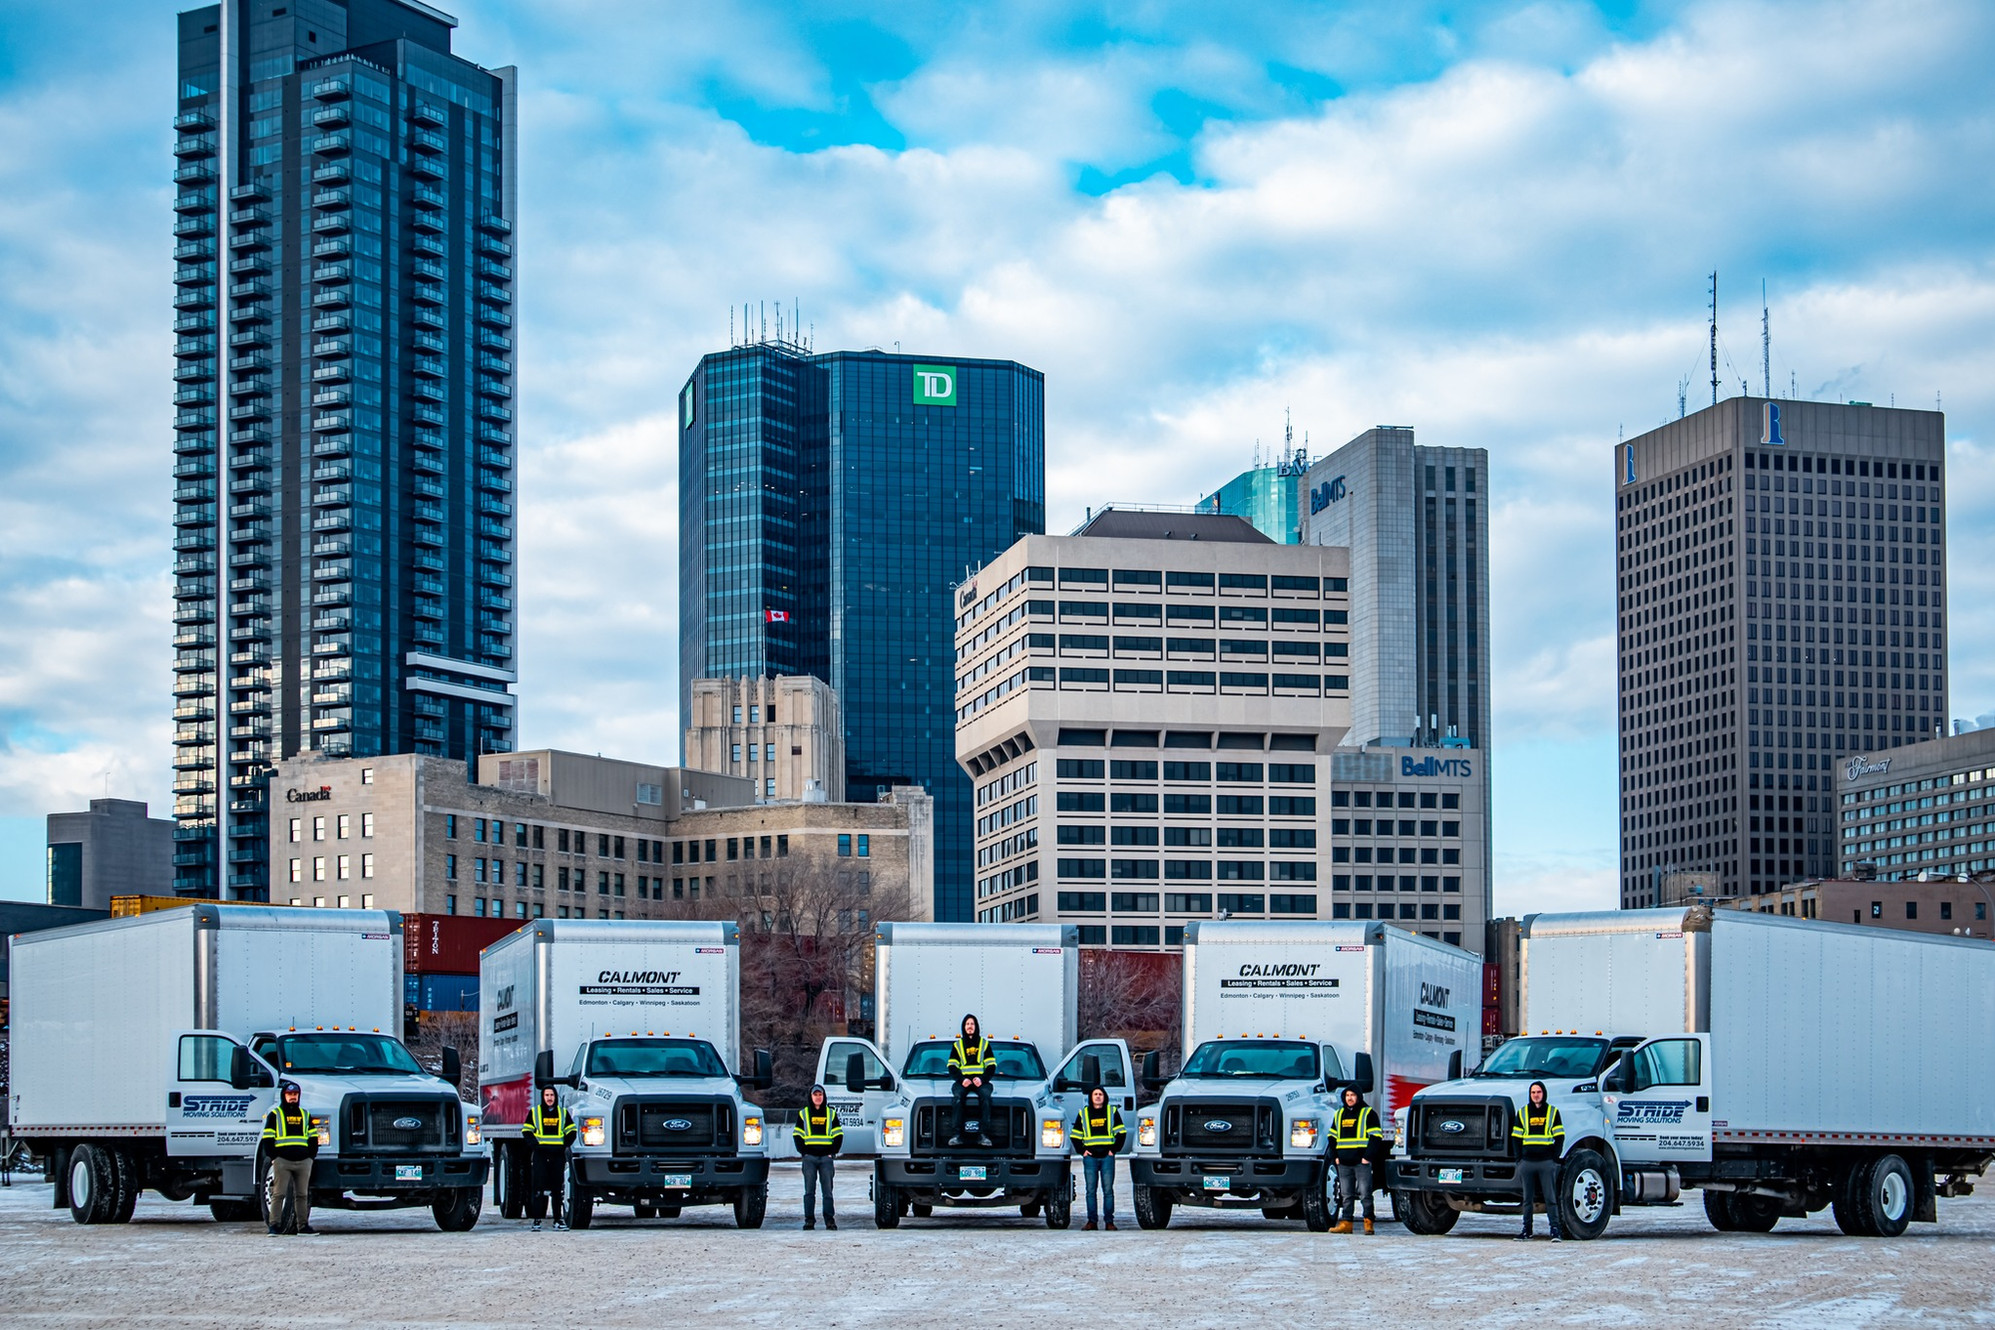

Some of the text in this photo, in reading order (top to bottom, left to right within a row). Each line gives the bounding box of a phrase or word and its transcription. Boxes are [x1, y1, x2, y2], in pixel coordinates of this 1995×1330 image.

[917, 372, 953, 398] TD
[1278, 461, 1310, 477] BM
[1401, 756, 1472, 777] BellMTS
[287, 786, 331, 803] Canada
[432, 921, 440, 954] TRITON
[598, 970, 681, 983] CALMONT
[1239, 964, 1321, 976] CALMONT
[183, 1095, 250, 1111] STRIDE
[1618, 1101, 1686, 1117] STRIDE
[964, 1121, 980, 1131] Ford
